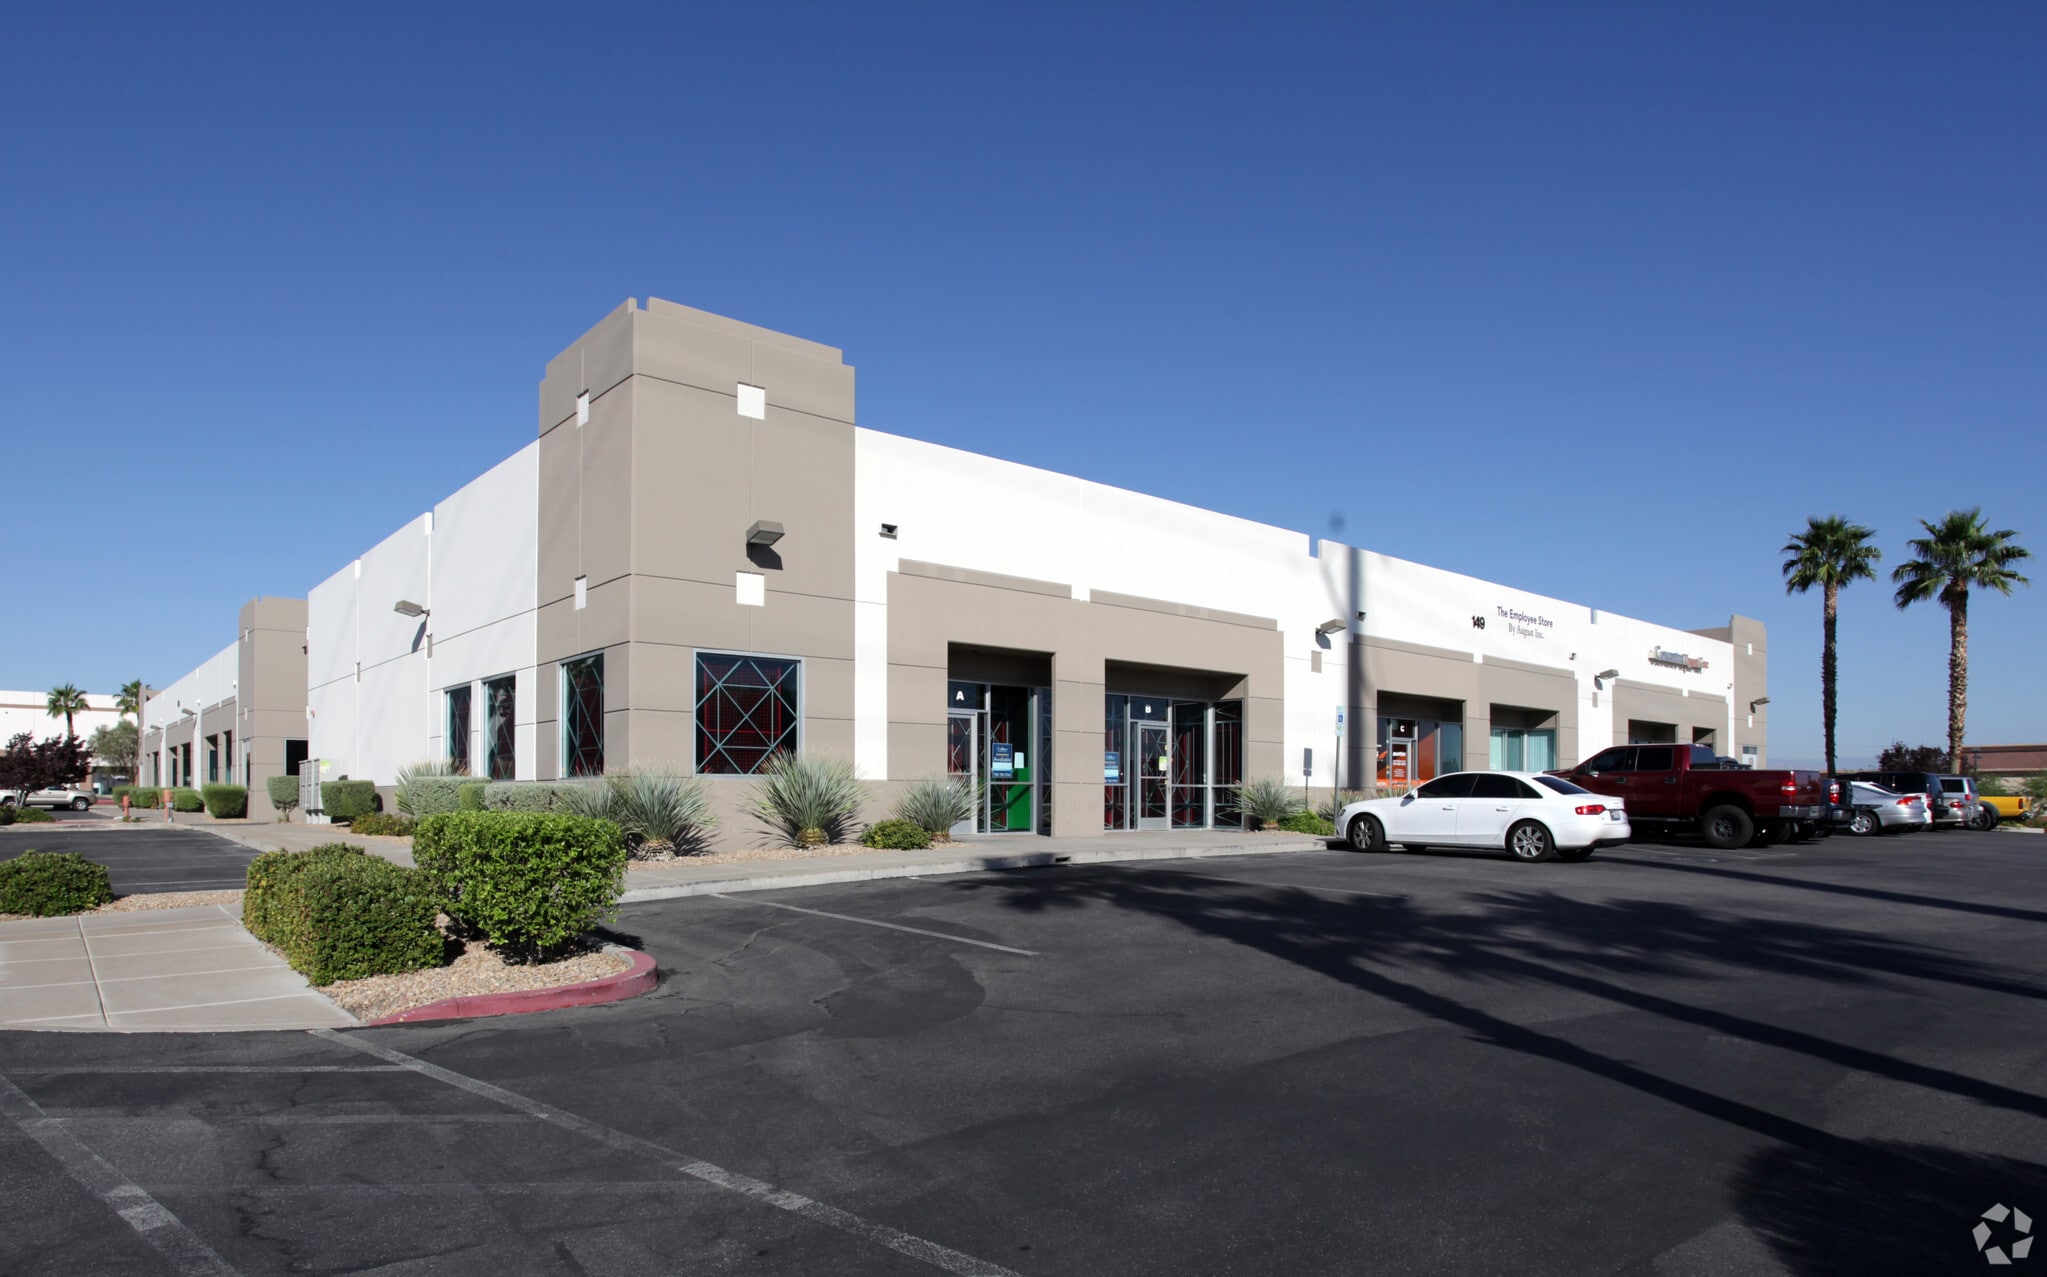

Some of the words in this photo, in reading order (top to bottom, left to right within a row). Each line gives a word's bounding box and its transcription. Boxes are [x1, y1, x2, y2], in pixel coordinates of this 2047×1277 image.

[1472, 616, 1485, 630] 149
[1497, 606, 1508, 618] The
[1510, 609, 1537, 626] Employee
[1538, 616, 1553, 628] Store
[1508, 623, 1515, 636] By
[1517, 625, 1534, 639] August
[956, 690, 965, 700] A
[1400, 725, 1406, 733] C
